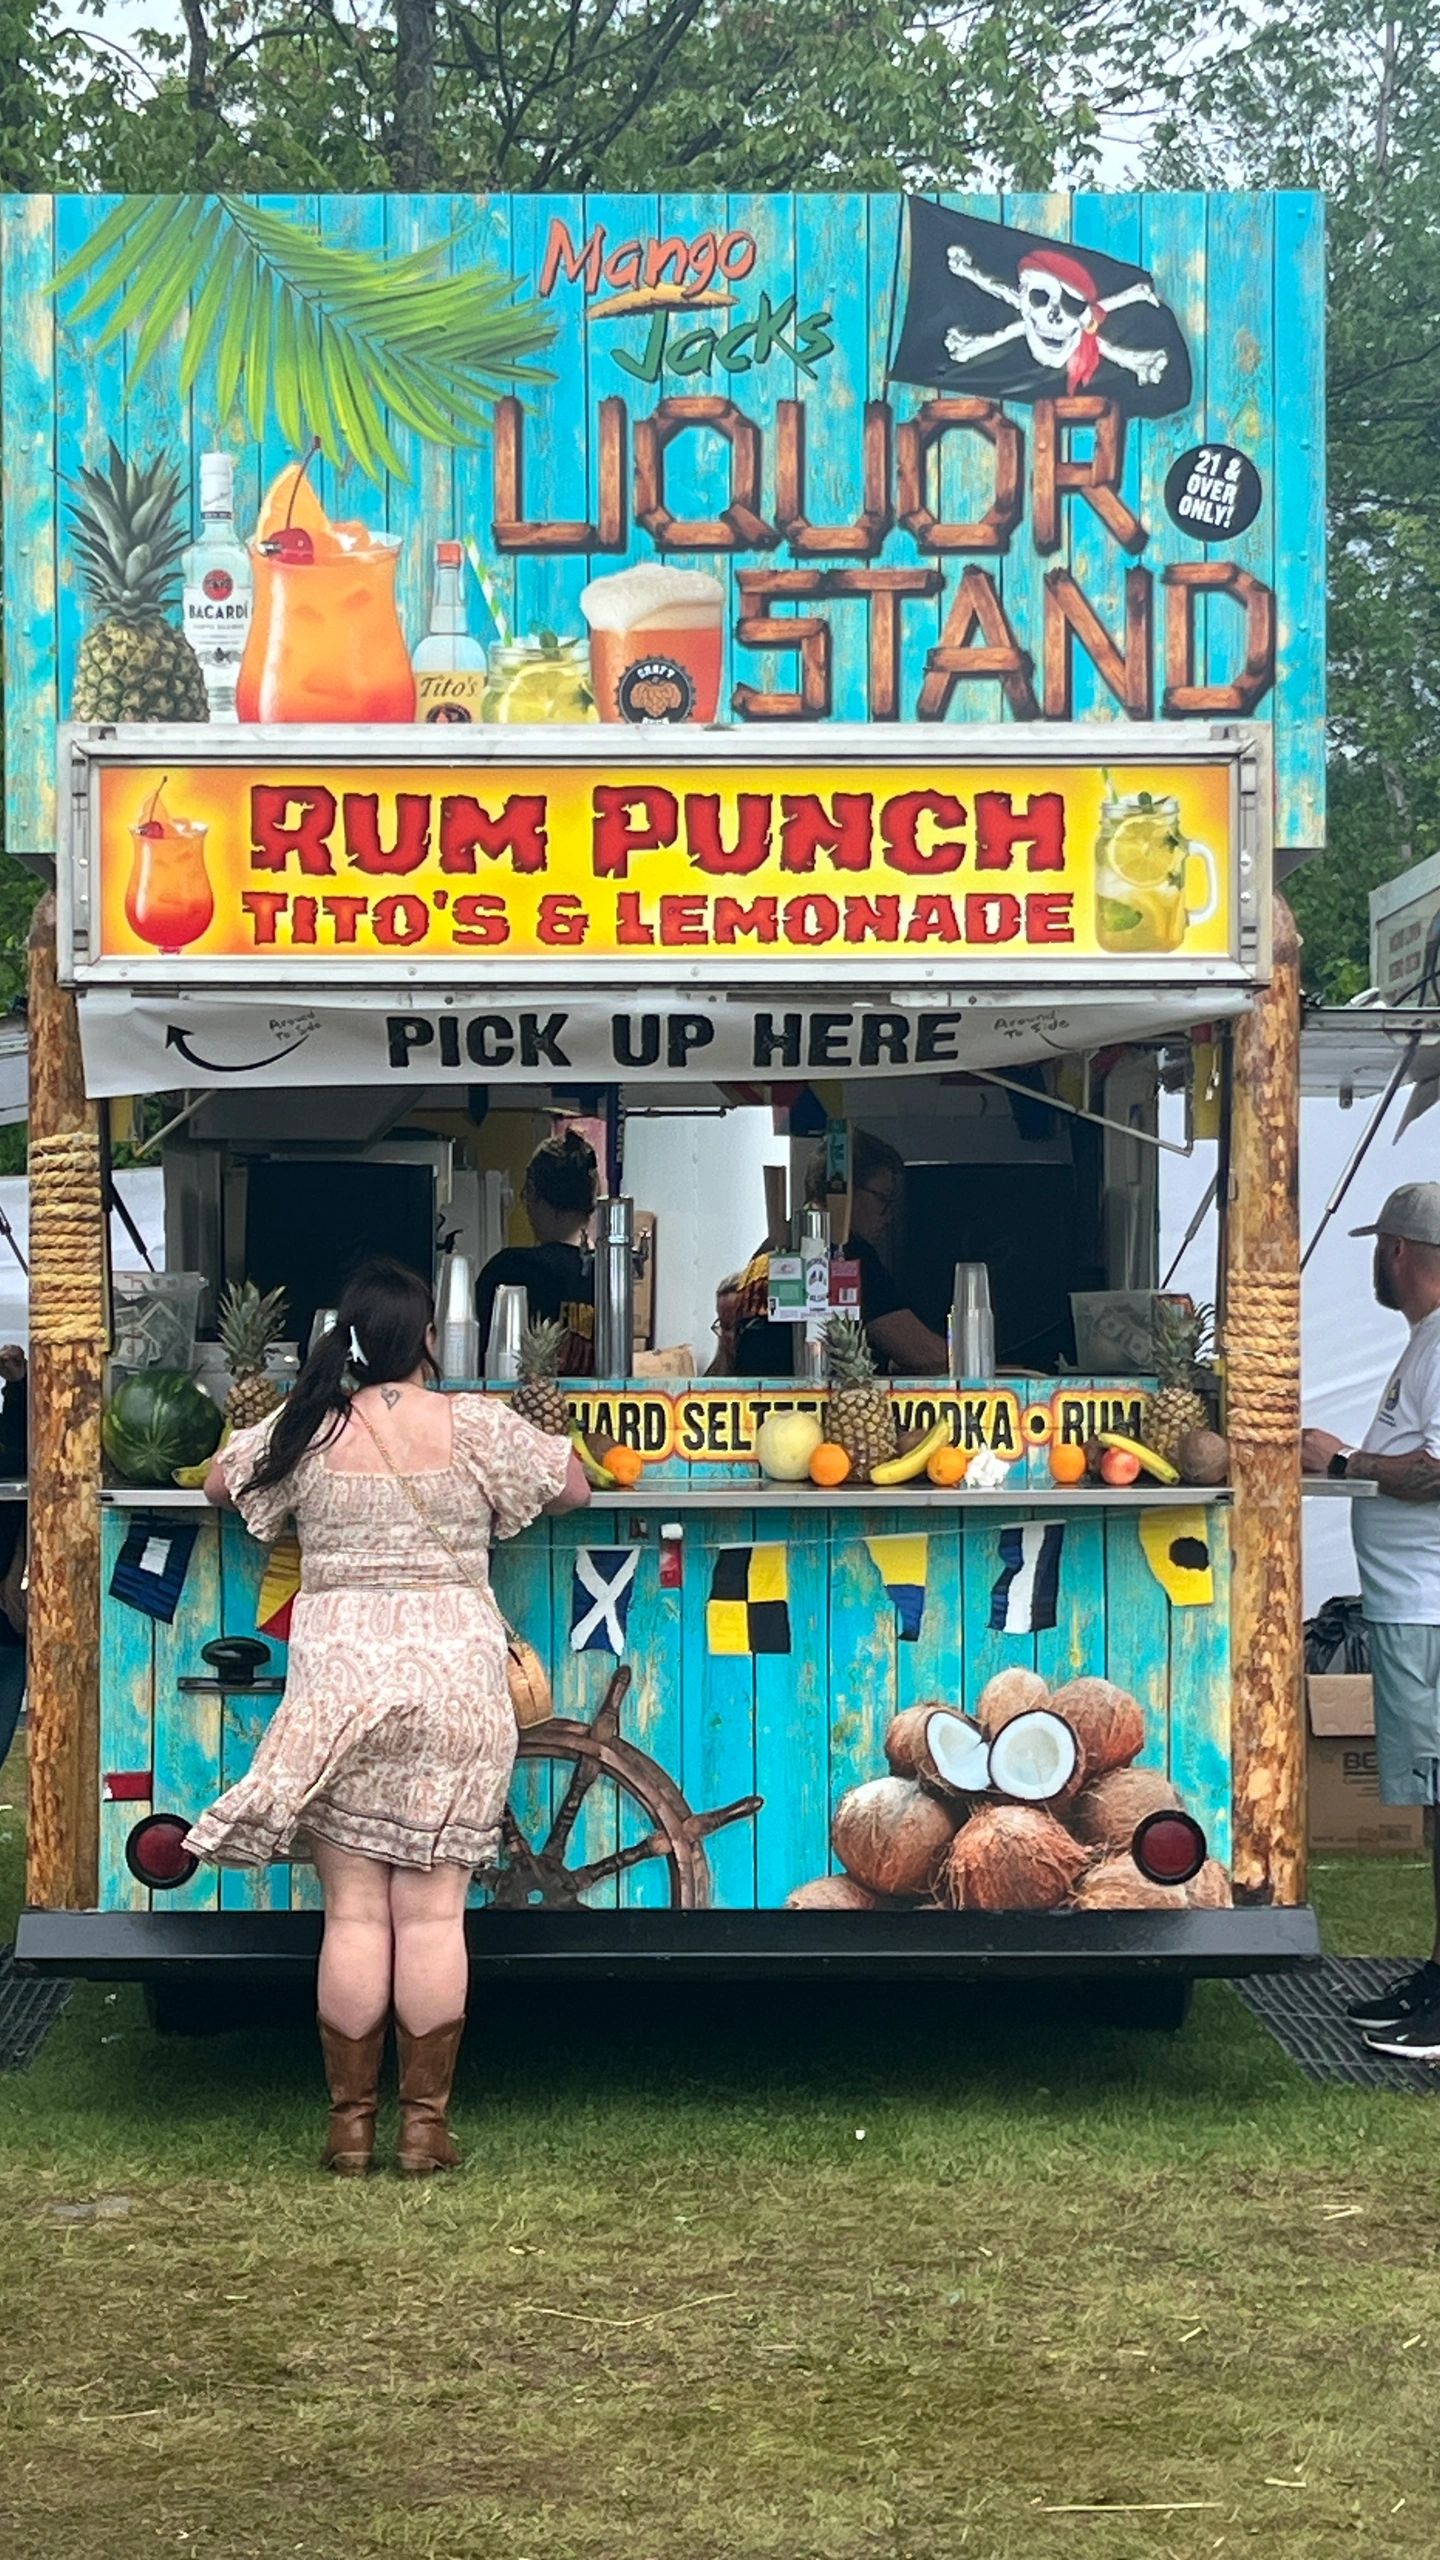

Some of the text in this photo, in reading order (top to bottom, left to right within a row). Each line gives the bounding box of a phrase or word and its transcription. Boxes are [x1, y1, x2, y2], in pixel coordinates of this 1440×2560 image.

[538, 218, 757, 298] Mango
[610, 290, 834, 384] Jacks
[492, 395, 1149, 558] LIQUOR
[1186, 472, 1239, 505] OVER
[1194, 449, 1242, 482] 21 &
[1178, 495, 1235, 528] ONLY!
[731, 561, 1276, 721] STAND
[420, 674, 478, 698] Tito's
[250, 785, 1066, 878] RUM PUNCH
[242, 890, 1075, 946] TITO'S & LEMONADE
[387, 1012, 961, 1068] PICK UP HERE
[993, 1009, 1056, 1031] Around
[568, 1402, 829, 1451] HARD SELT
[891, 1401, 1141, 1450] VODKA RUM
[1344, 1752, 1379, 1769] BE
